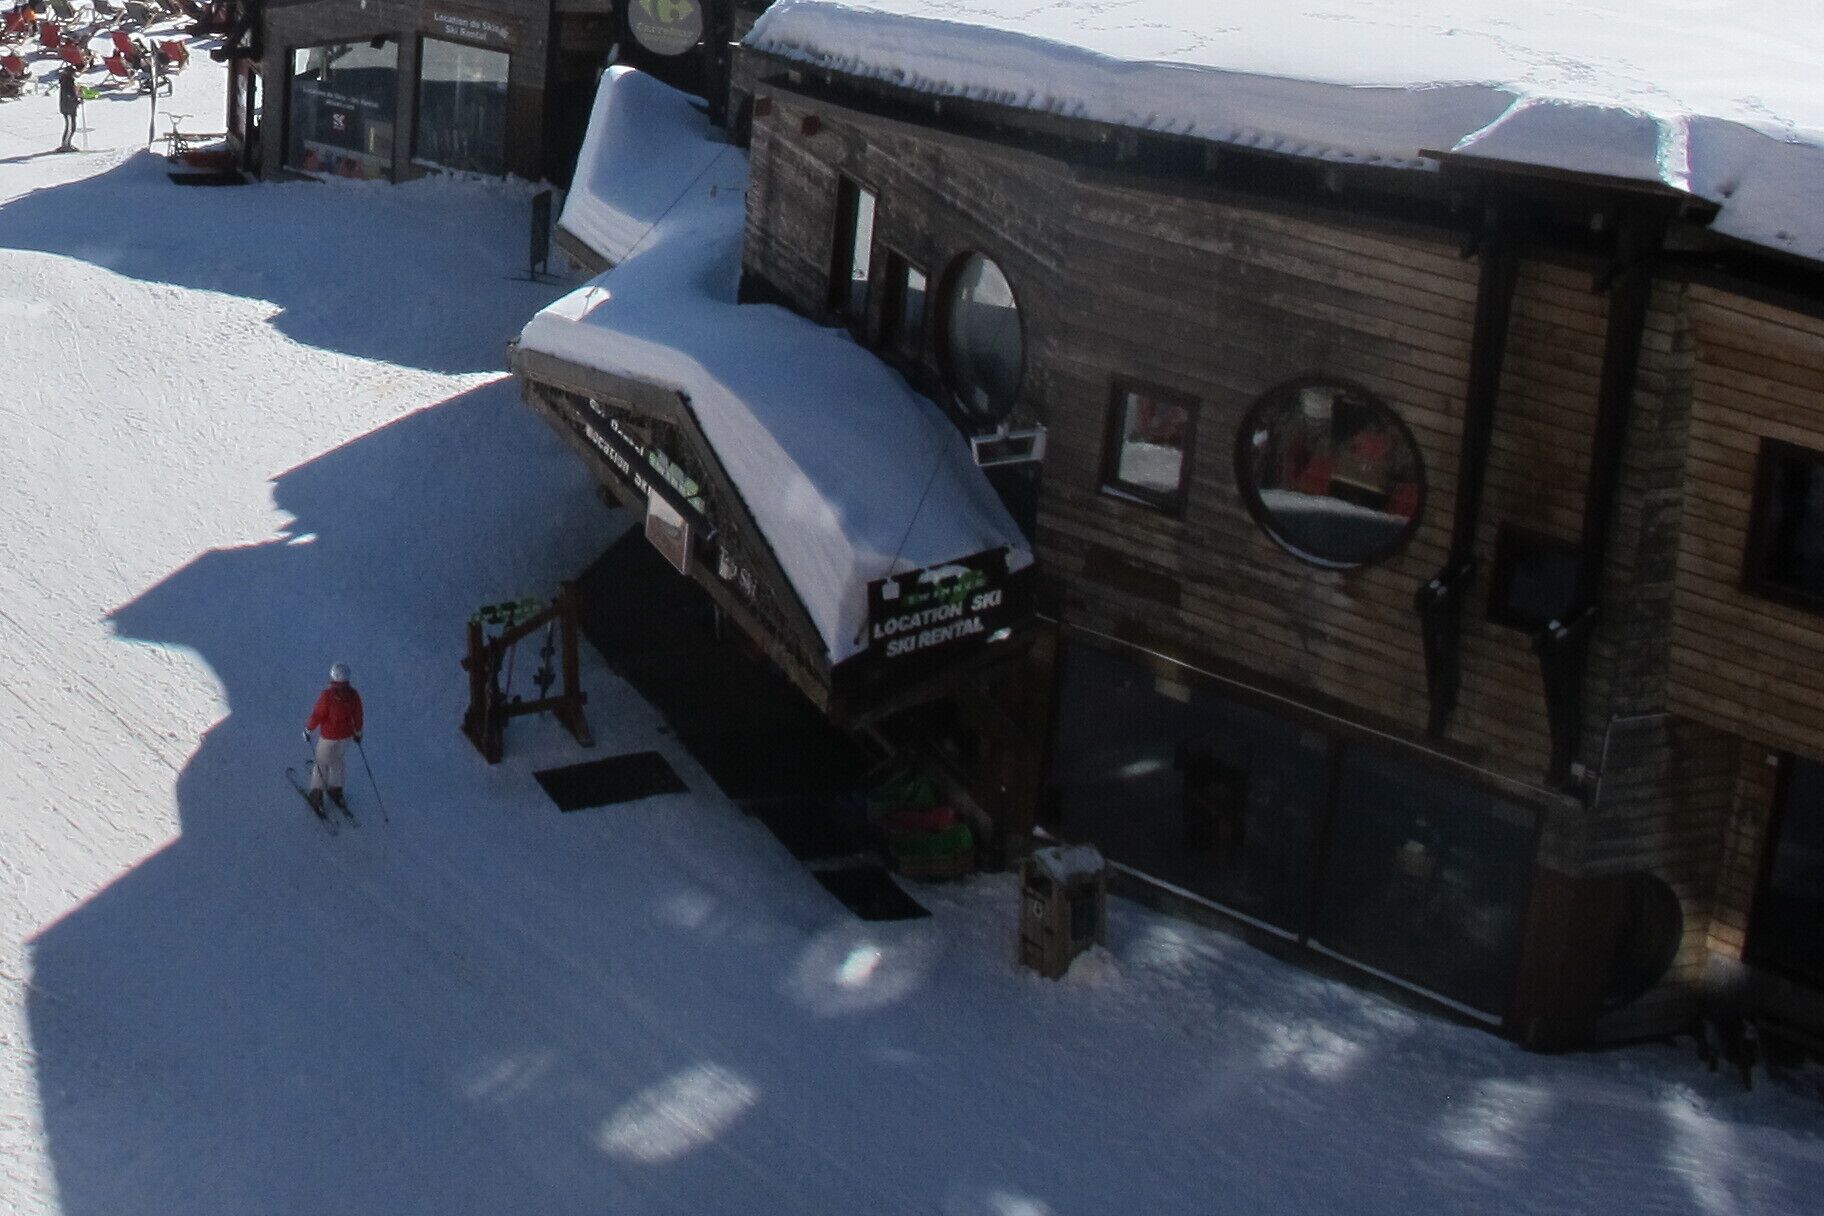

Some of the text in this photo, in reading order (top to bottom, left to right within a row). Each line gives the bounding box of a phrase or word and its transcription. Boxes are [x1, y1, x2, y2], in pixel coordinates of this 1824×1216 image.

[873, 589, 1003, 640] LOCATION SKI
[885, 616, 985, 659] SKI RENTAL
